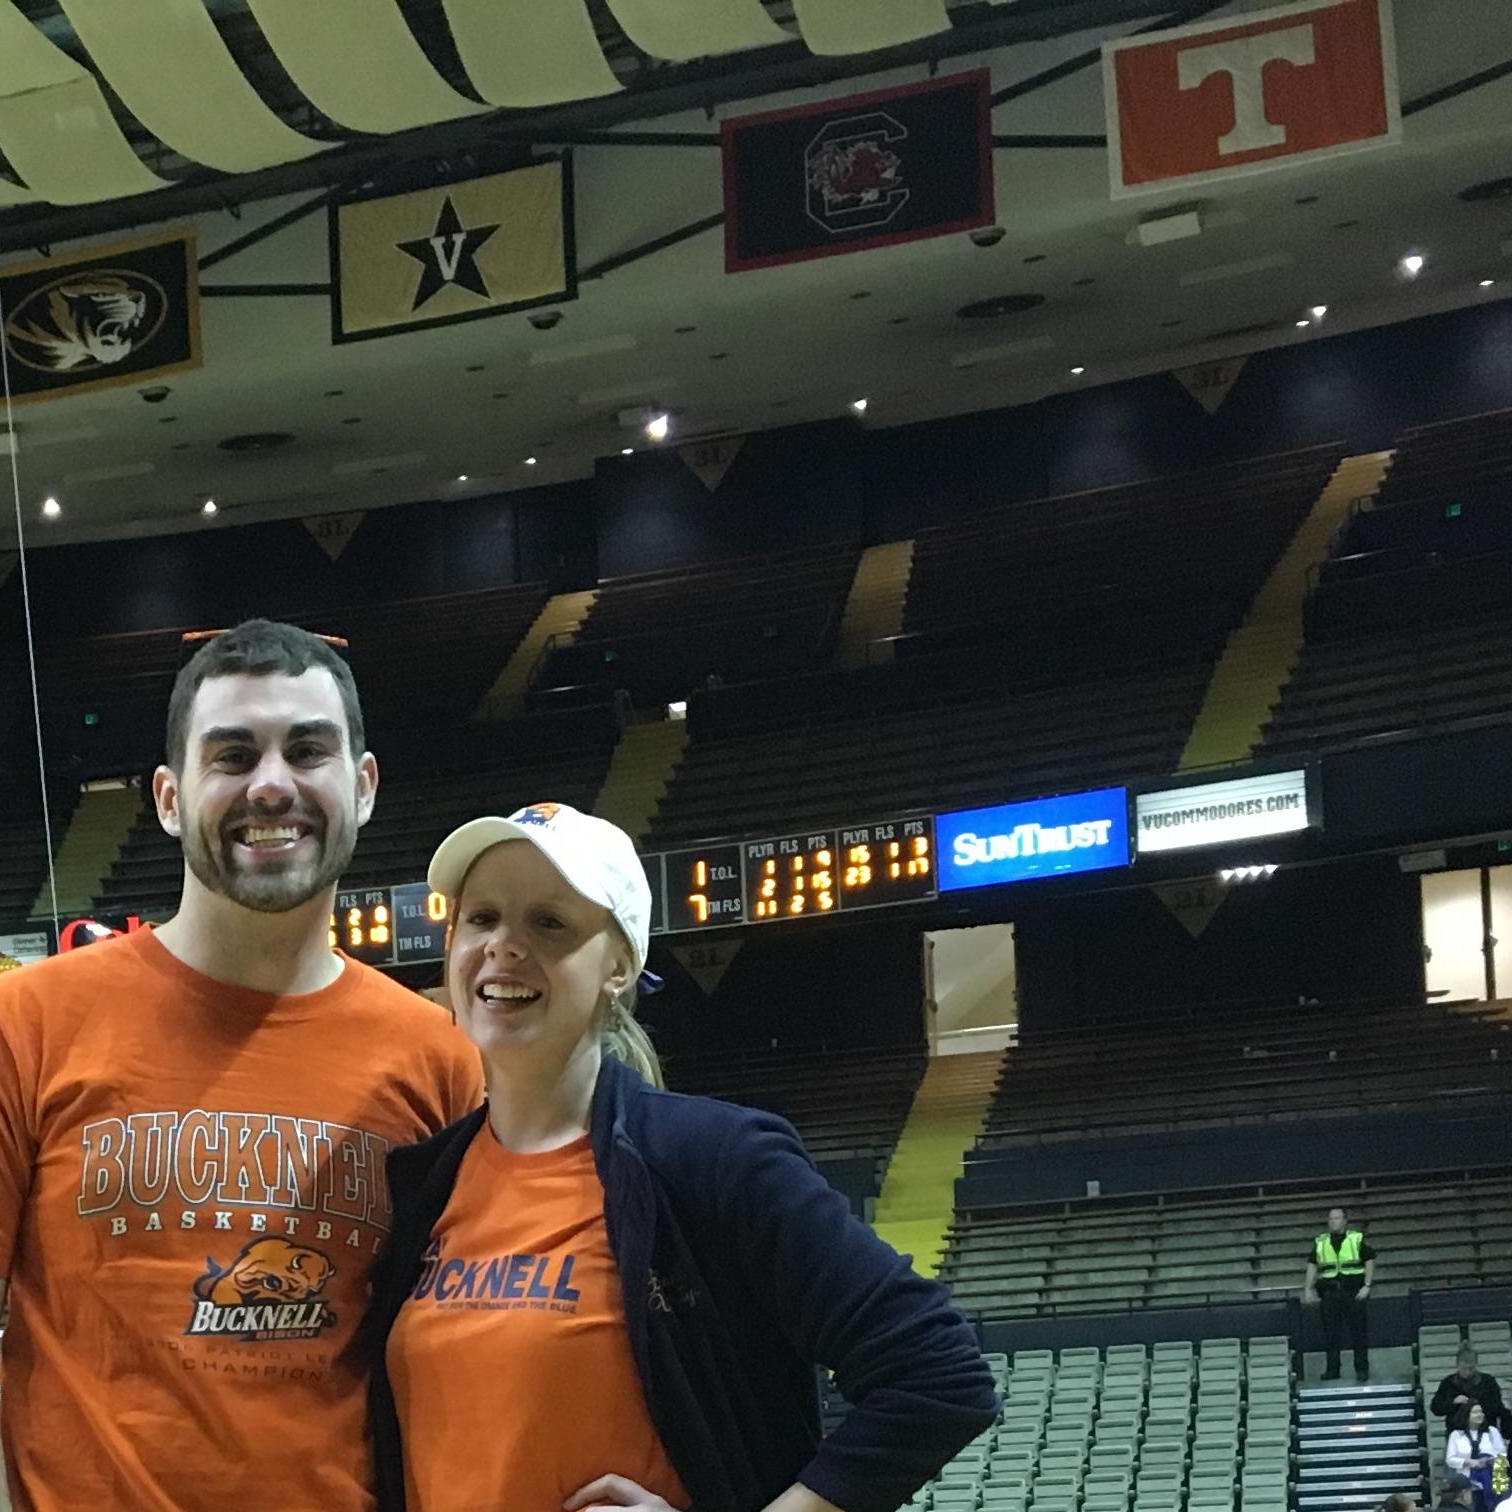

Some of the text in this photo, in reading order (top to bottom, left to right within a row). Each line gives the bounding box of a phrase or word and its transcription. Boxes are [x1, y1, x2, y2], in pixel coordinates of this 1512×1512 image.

[1176, 23, 1316, 156] T
[427, 230, 467, 282] V
[1141, 793, 1300, 831] VUCOMMODORES.COM
[749, 835, 826, 857] PLYR FLS PTS
[843, 821, 924, 844] PLYR FLS PTS
[696, 860, 706, 886] 1
[340, 892, 383, 907] FLS PTS
[428, 892, 447, 921] 0
[689, 894, 707, 921] 7
[723, 898, 741, 912] FLS
[415, 935, 432, 949] FLS
[78, 1109, 393, 1232] BUCKNEL
[410, 1254, 581, 1302] UCKNELL
[190, 1300, 325, 1333] BUCKNELL
[255, 1328, 315, 1341] BISON
